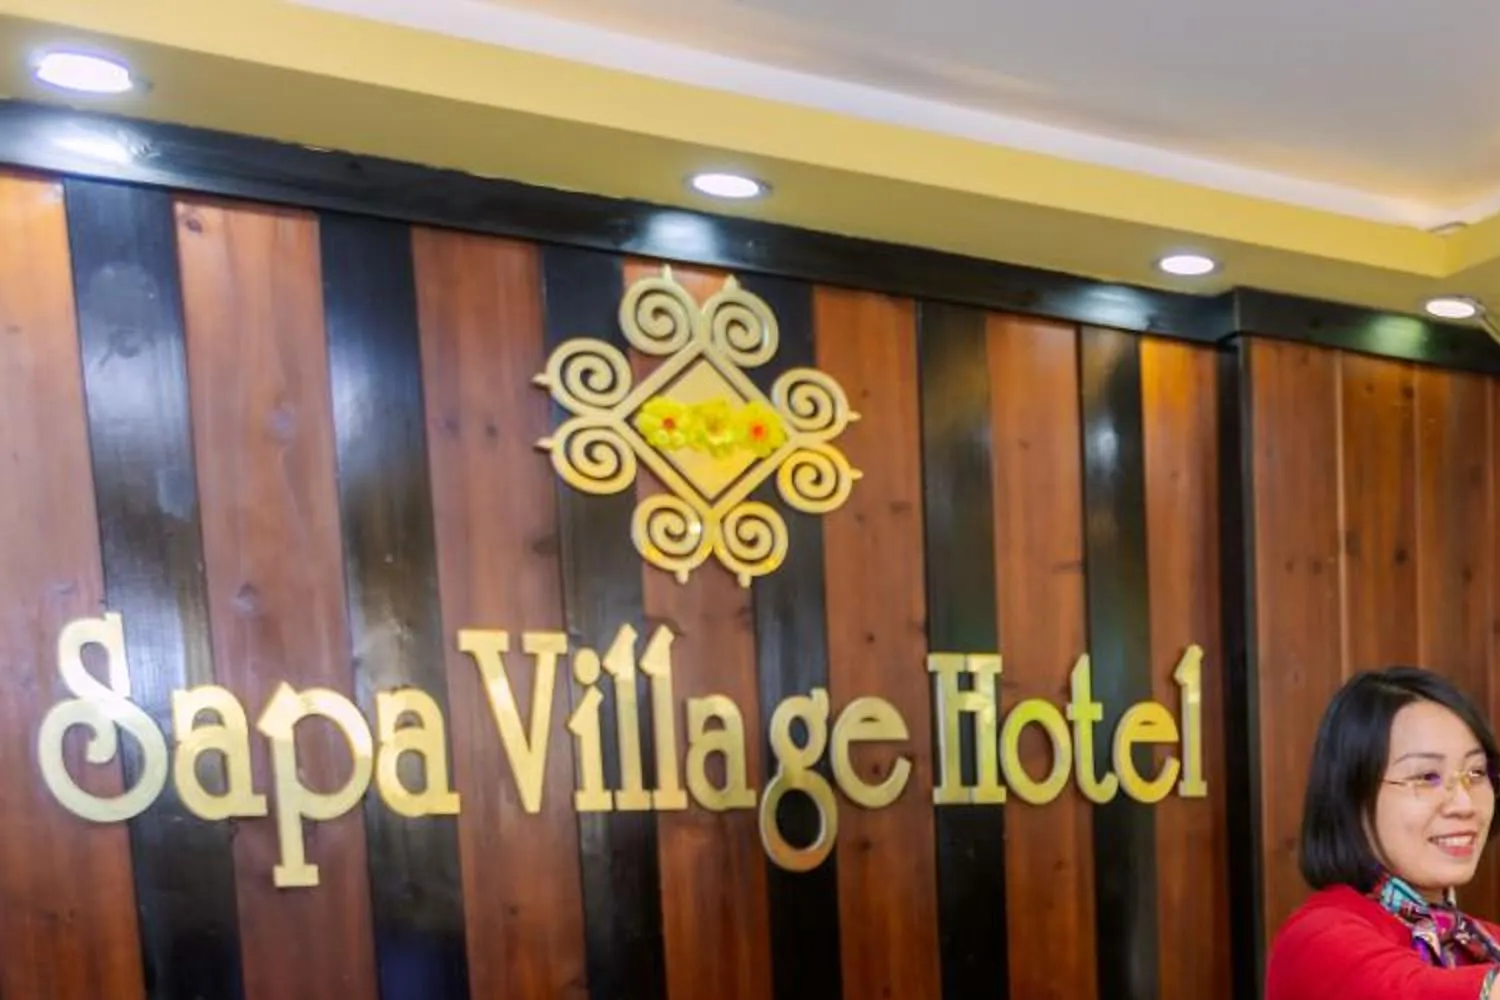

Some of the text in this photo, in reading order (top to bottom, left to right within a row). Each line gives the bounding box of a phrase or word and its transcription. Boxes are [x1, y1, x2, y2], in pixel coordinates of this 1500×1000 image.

[38, 611, 1208, 887] Sapa Village Hotel
